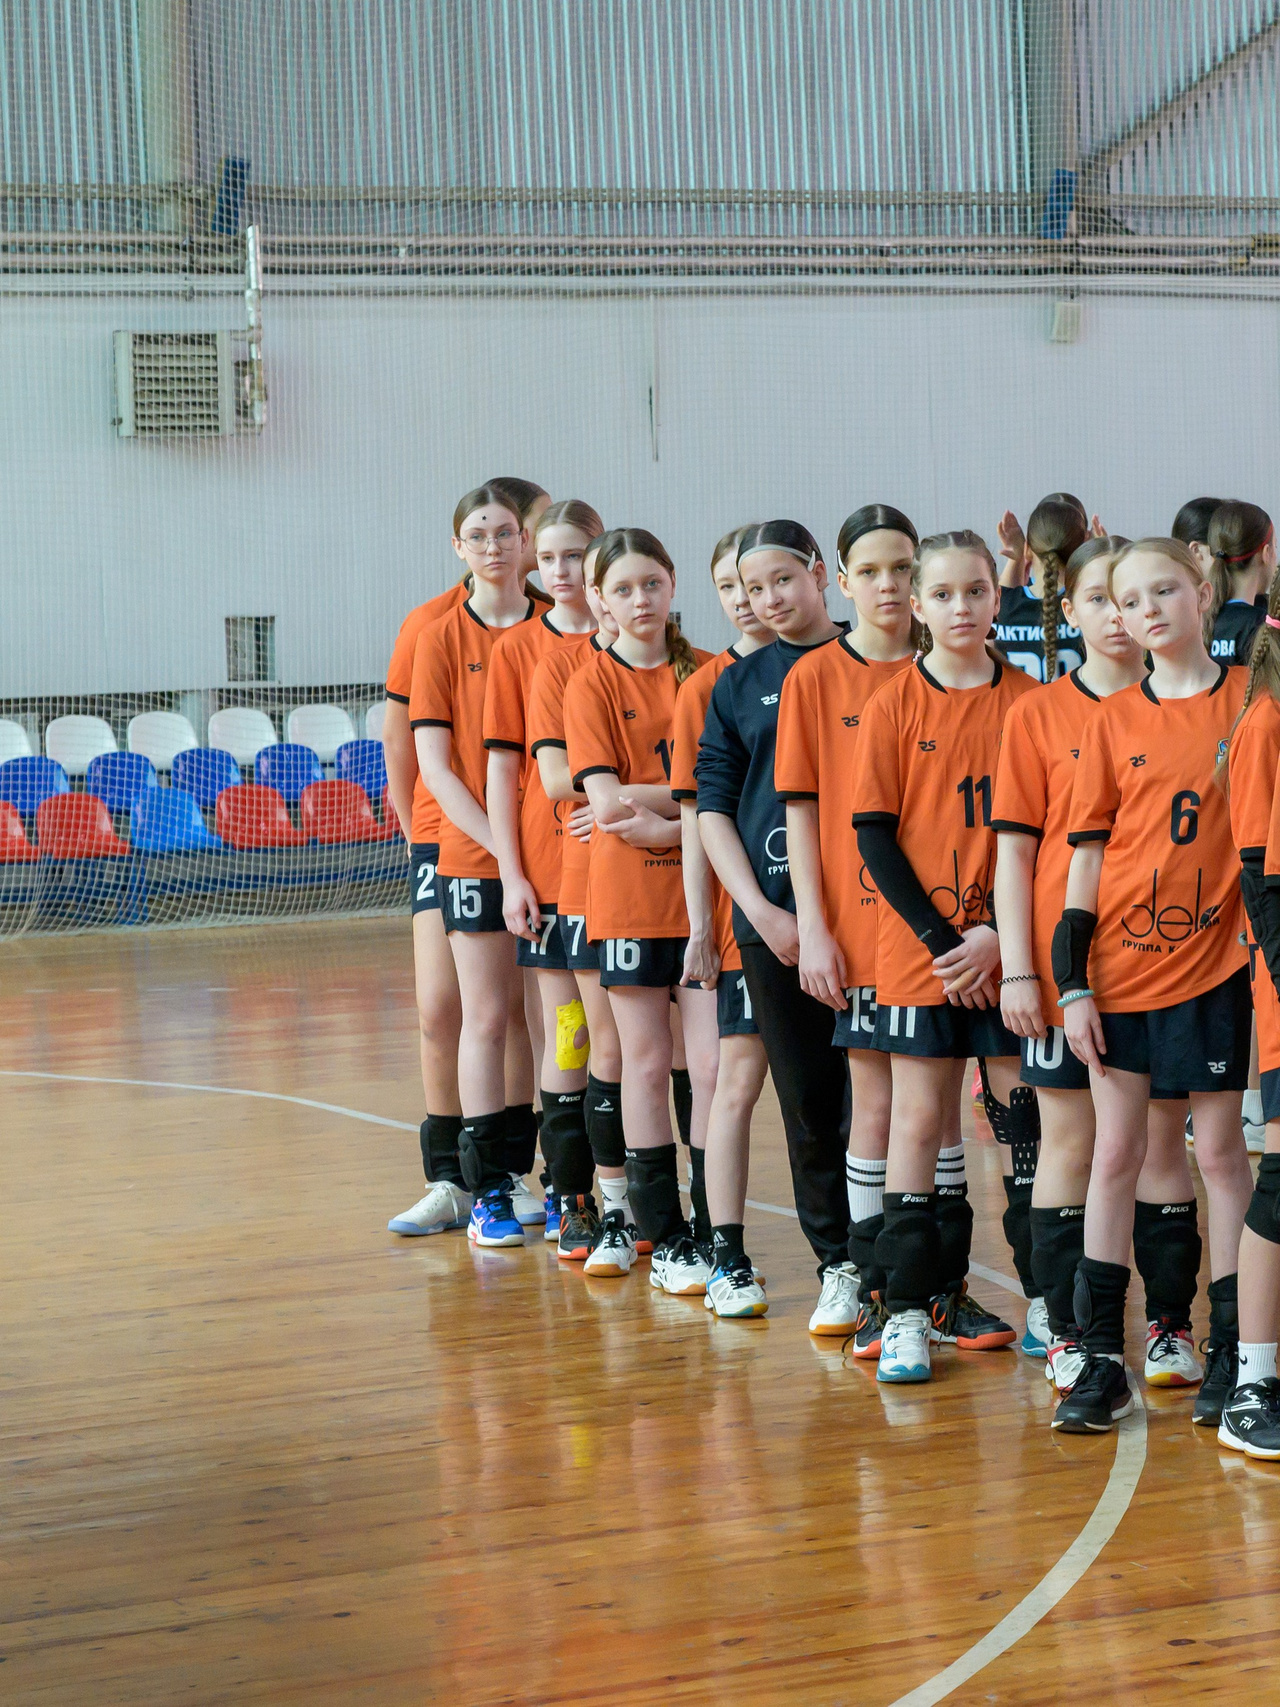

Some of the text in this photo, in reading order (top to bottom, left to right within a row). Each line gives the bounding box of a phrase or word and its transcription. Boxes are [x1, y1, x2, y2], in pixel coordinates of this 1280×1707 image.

[957, 775, 992, 828] 11
[1170, 790, 1200, 845] 6
[416, 862, 438, 901] 2
[448, 878, 482, 919] 15
[603, 938, 641, 972] 16
[1122, 939, 1162, 953] ГРУППА
[846, 986, 877, 1033] 13
